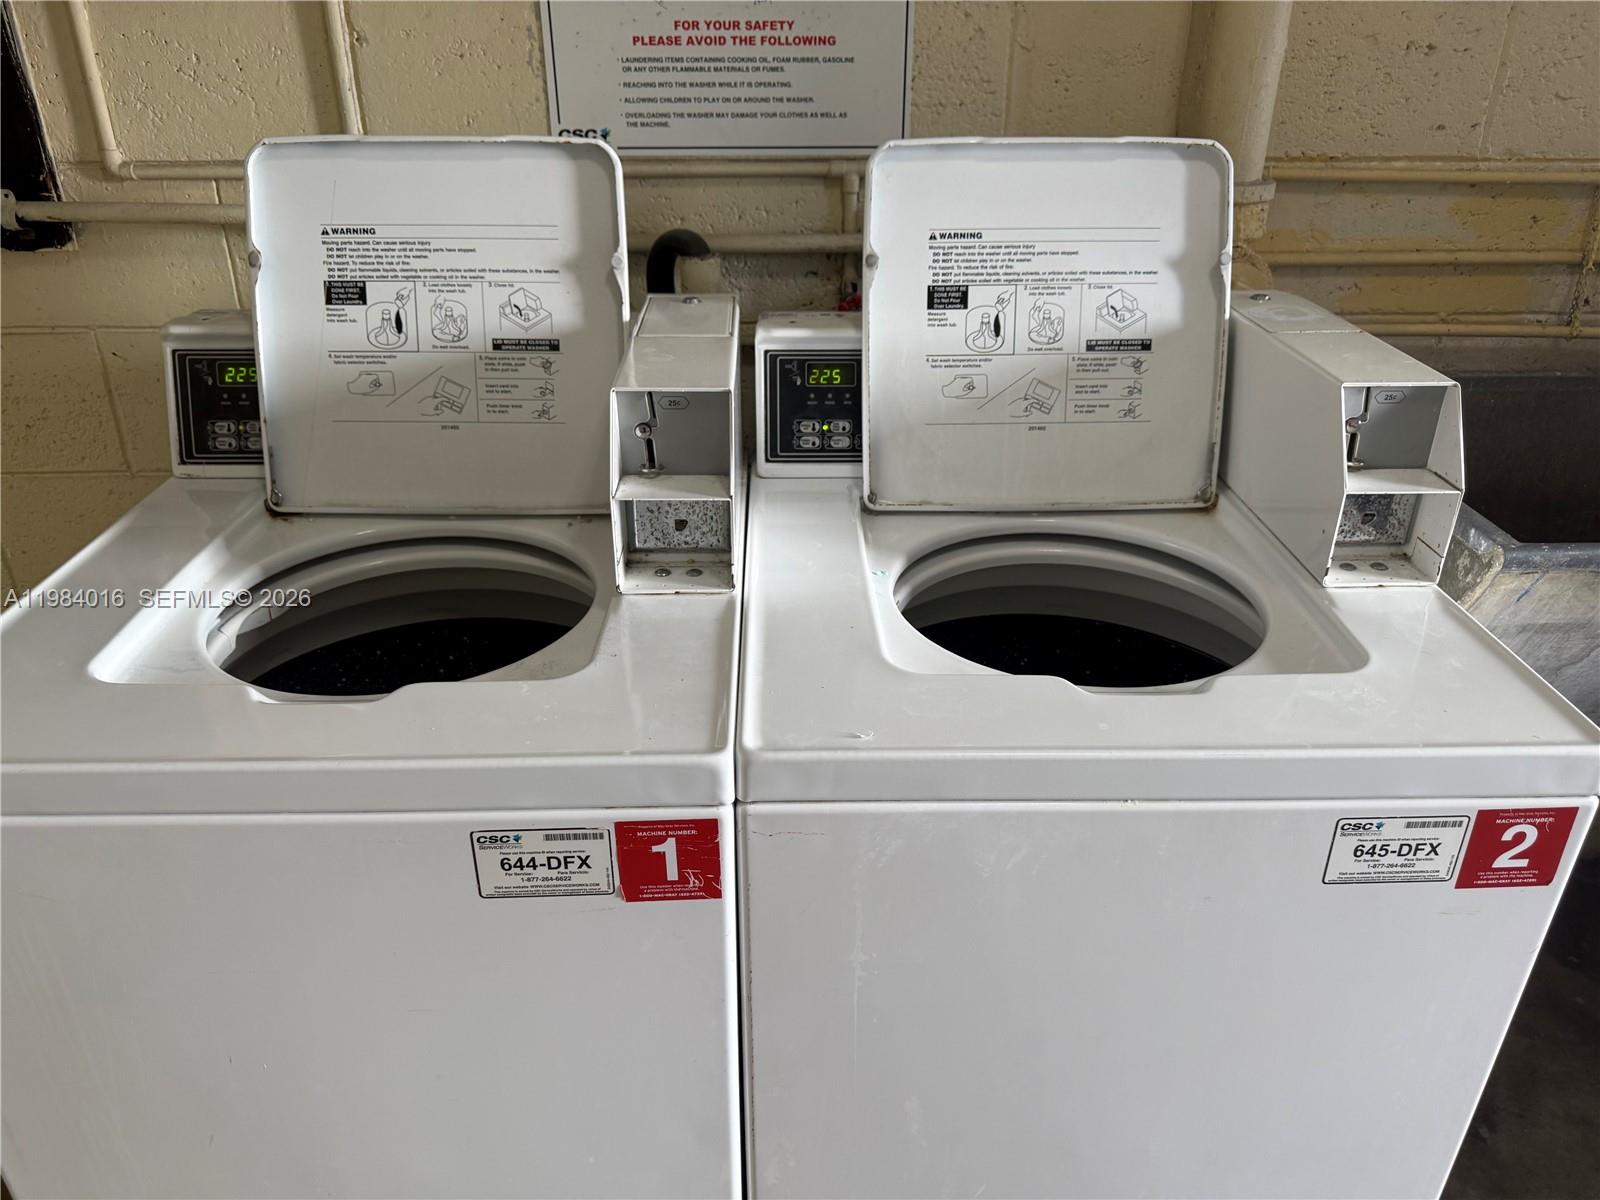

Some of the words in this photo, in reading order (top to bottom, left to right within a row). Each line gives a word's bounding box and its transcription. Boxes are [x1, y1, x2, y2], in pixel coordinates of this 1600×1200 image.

[674, 20, 700, 31] FOR
[705, 20, 741, 31] YOUR
[745, 20, 794, 31] SAFETY
[632, 36, 682, 46] PLEASE
[686, 36, 727, 46] AVOID
[732, 36, 756, 46] THE
[760, 36, 836, 46] FOLLOWING
[809, 369, 841, 384] 225
[1341, 823, 1374, 831] CSC
[1353, 842, 1441, 858] 645-DFX
[1492, 824, 1538, 868] 2
[500, 855, 591, 871] 644-DFX
[652, 837, 678, 881] 1
